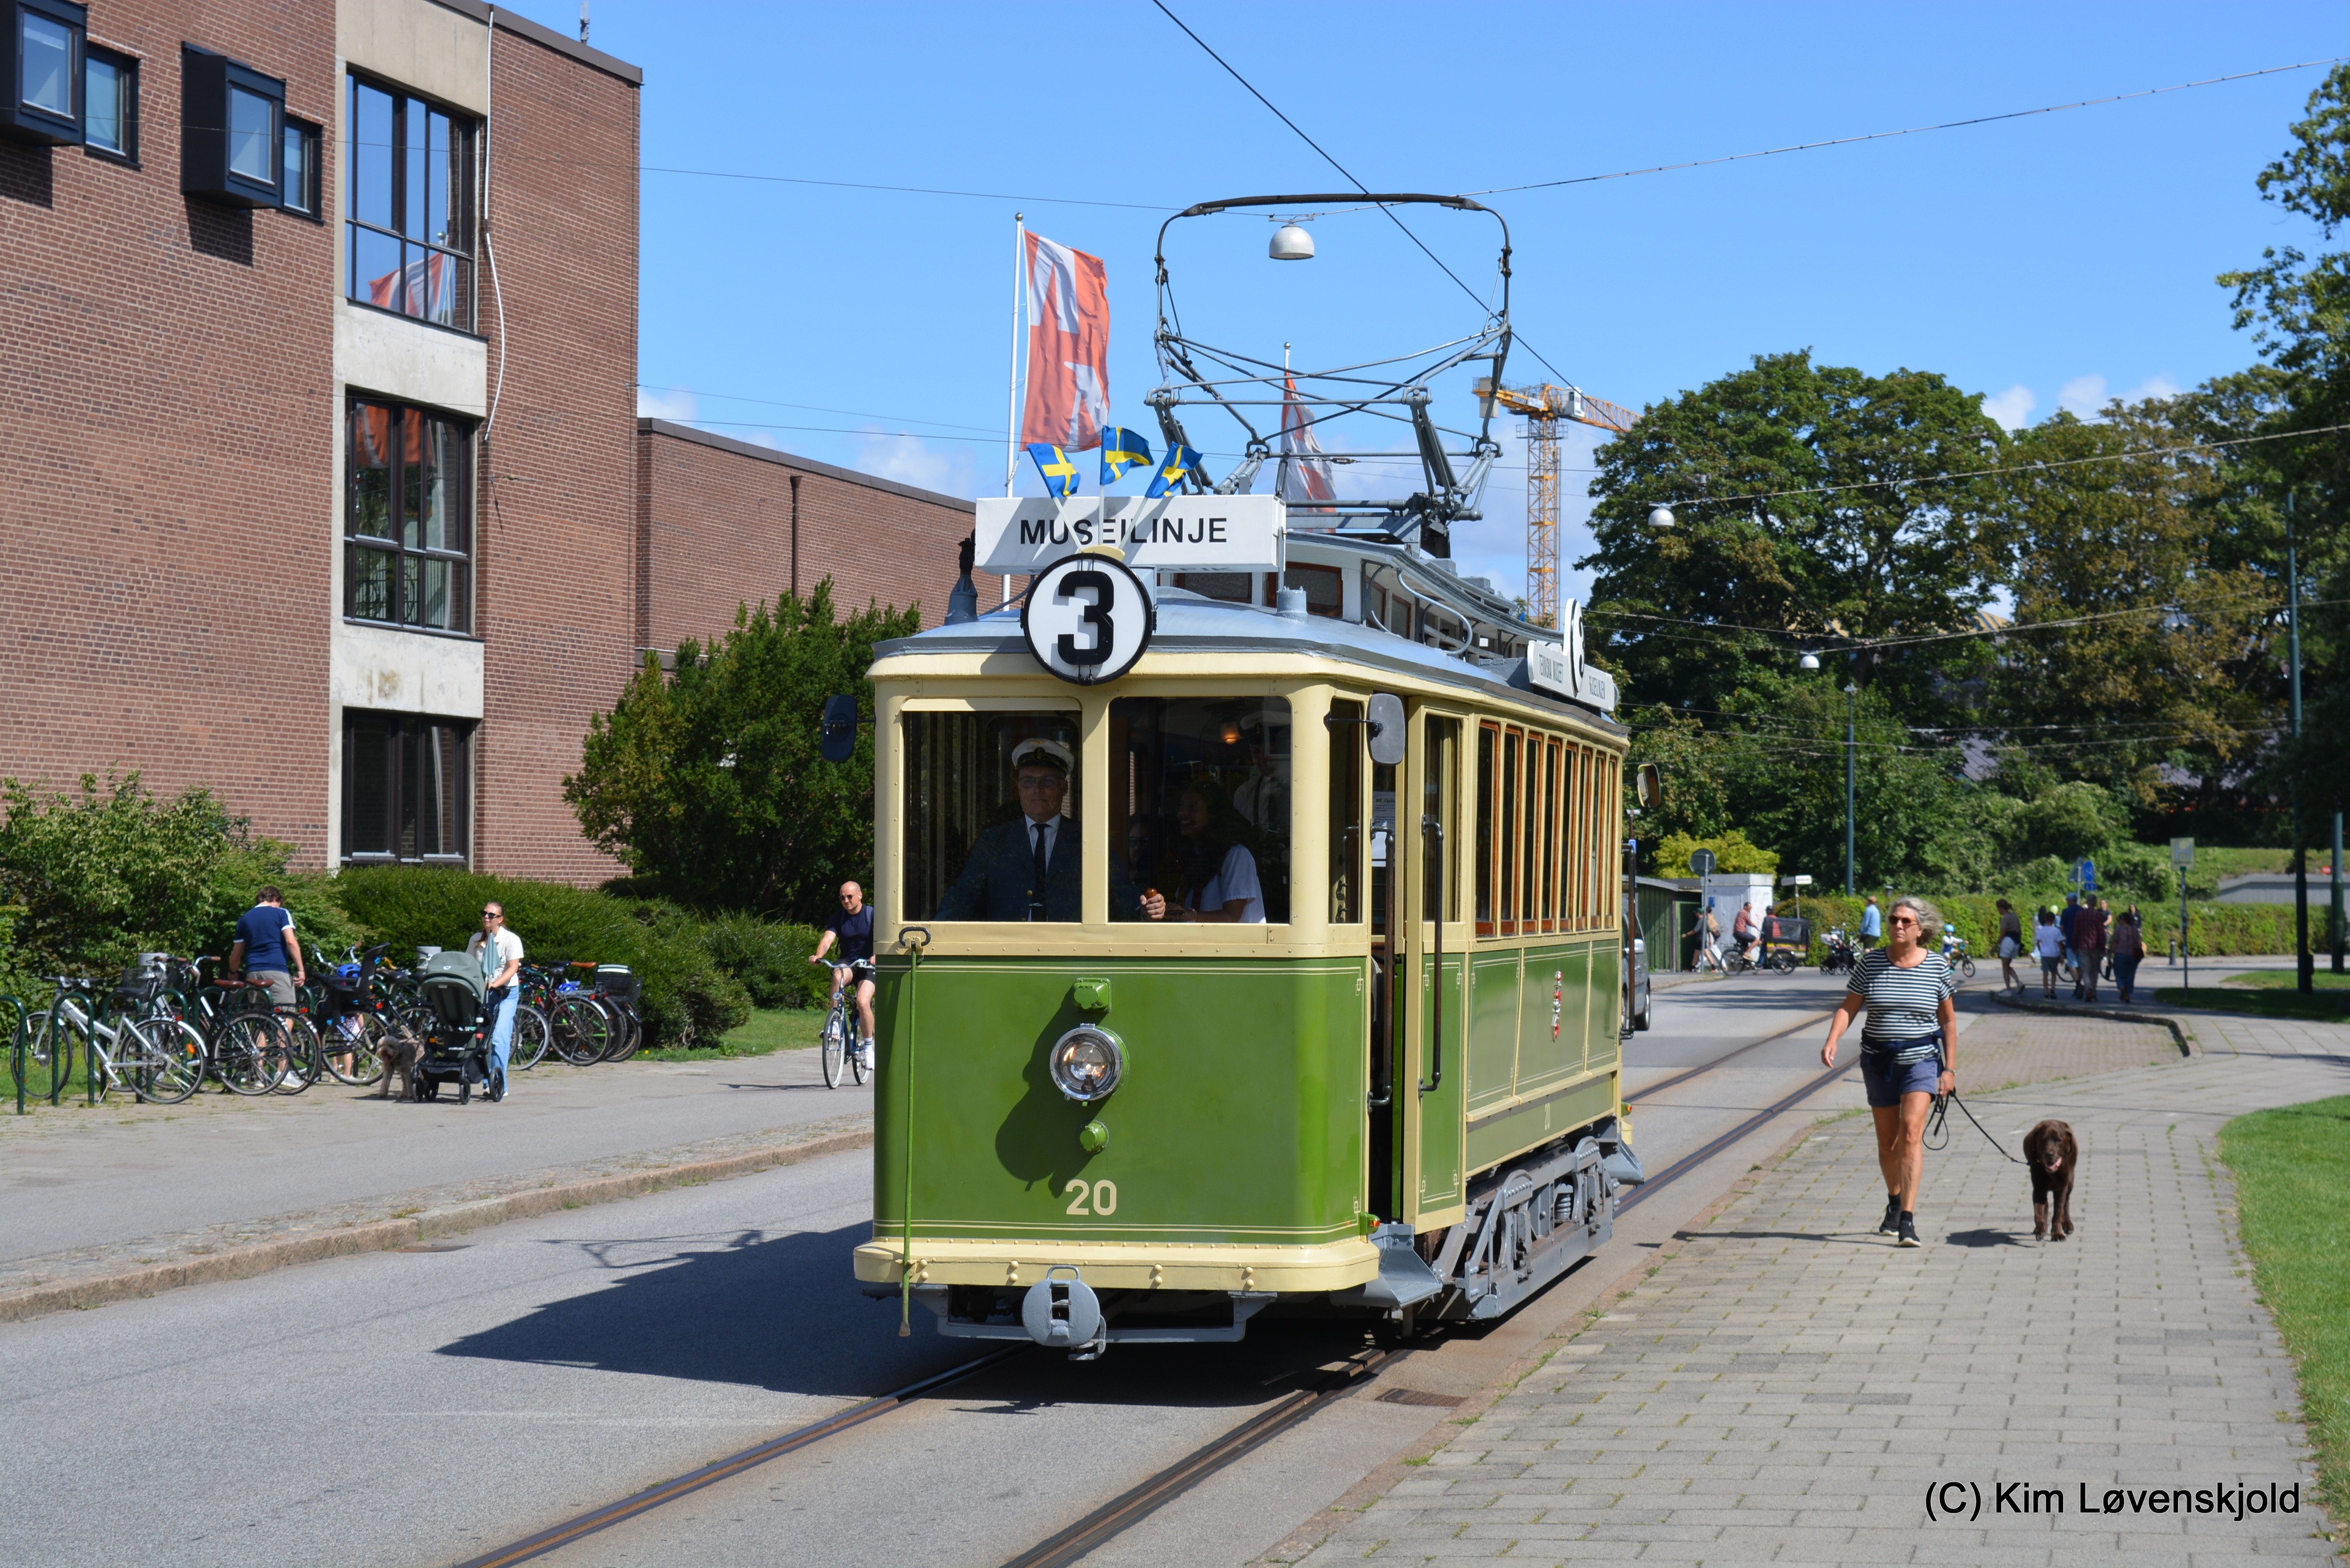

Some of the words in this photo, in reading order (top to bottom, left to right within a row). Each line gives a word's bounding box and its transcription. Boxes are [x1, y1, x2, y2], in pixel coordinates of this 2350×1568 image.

[1020, 518, 1226, 545] MUSEILINJE
[1057, 570, 1114, 665] 3
[1553, 660, 1564, 684] MUSEET
[1544, 1102, 1551, 1130] 20
[1065, 1179, 1117, 1216] 20
